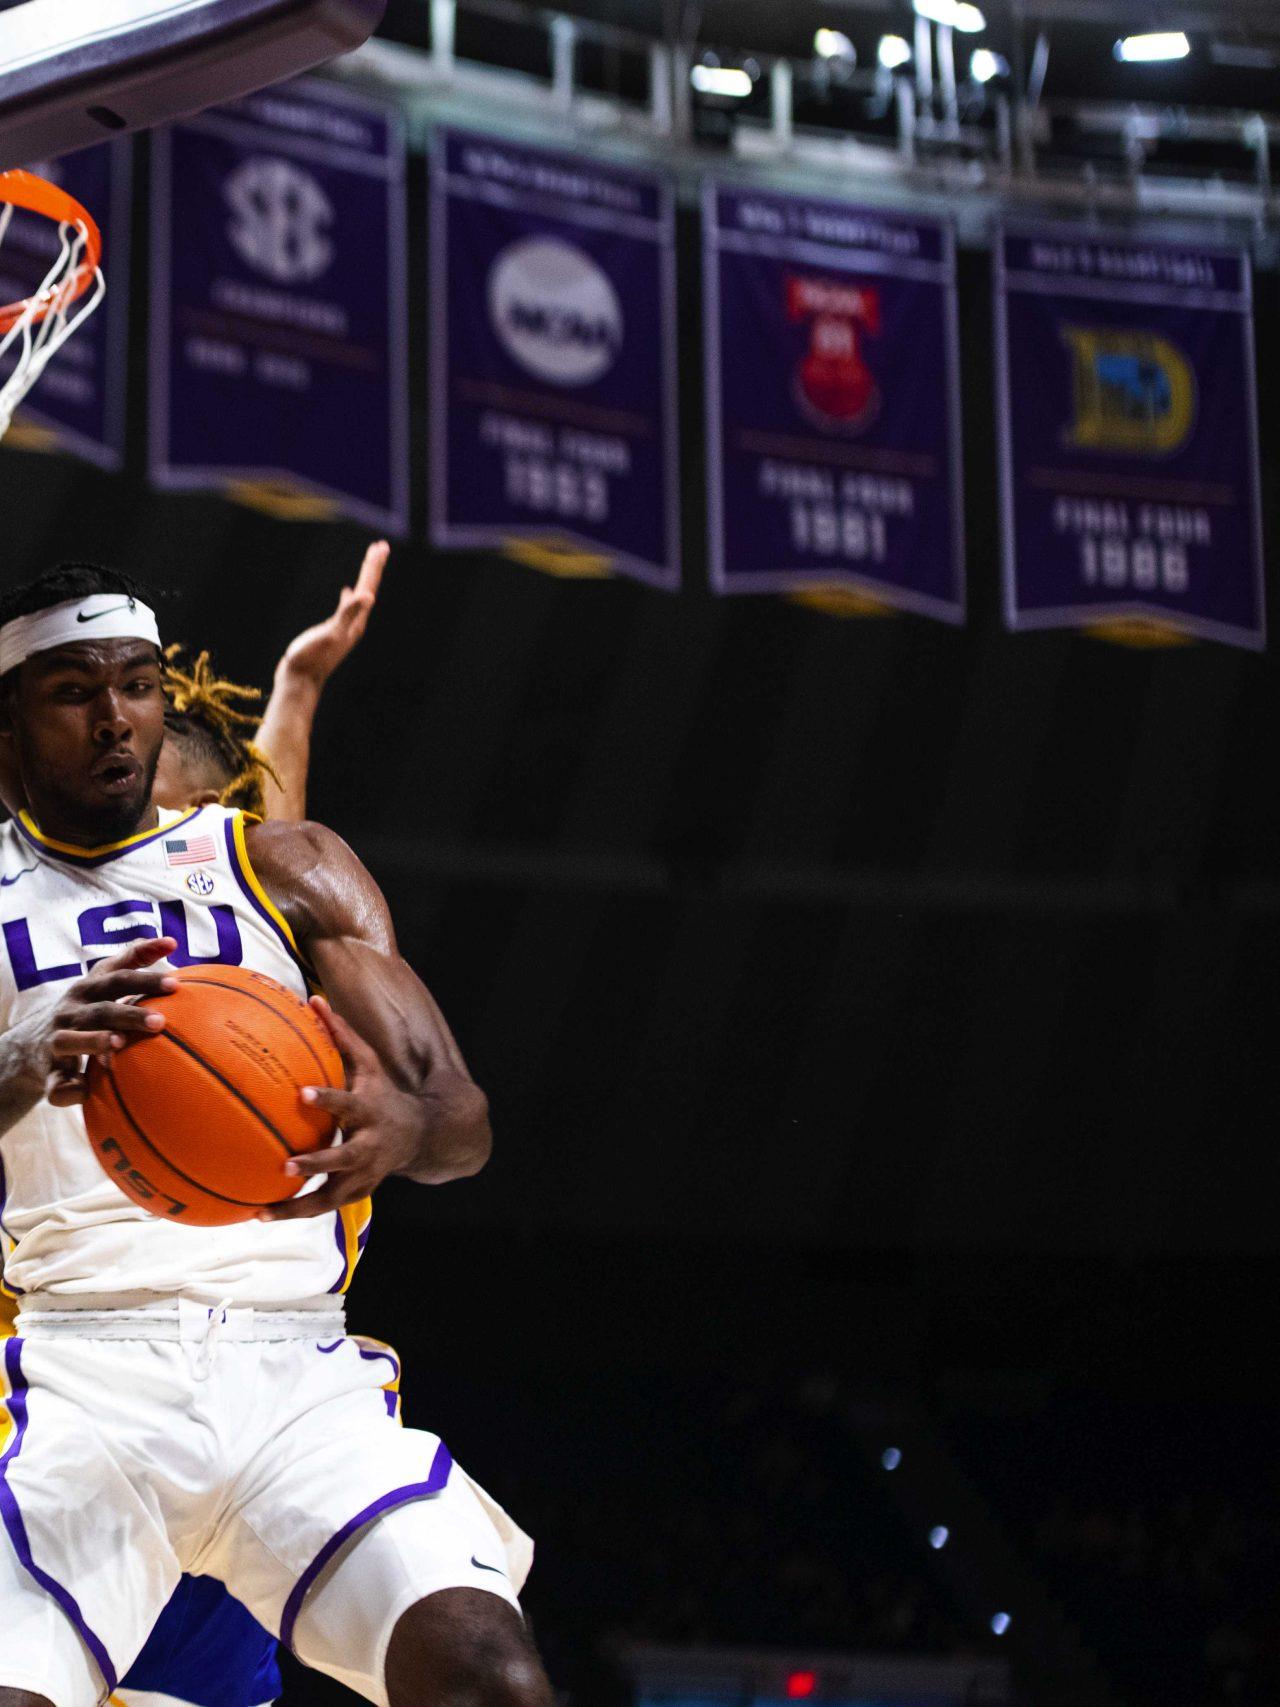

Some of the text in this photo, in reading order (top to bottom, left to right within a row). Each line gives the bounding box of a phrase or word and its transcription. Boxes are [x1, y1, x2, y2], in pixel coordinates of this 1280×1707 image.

[760, 457, 914, 516] FINAL FOUR
[1052, 496, 1212, 546] FINAL FOUR
[187, 871, 215, 896] SEC
[2, 899, 244, 992] LSU
[100, 1136, 188, 1217] LSU
